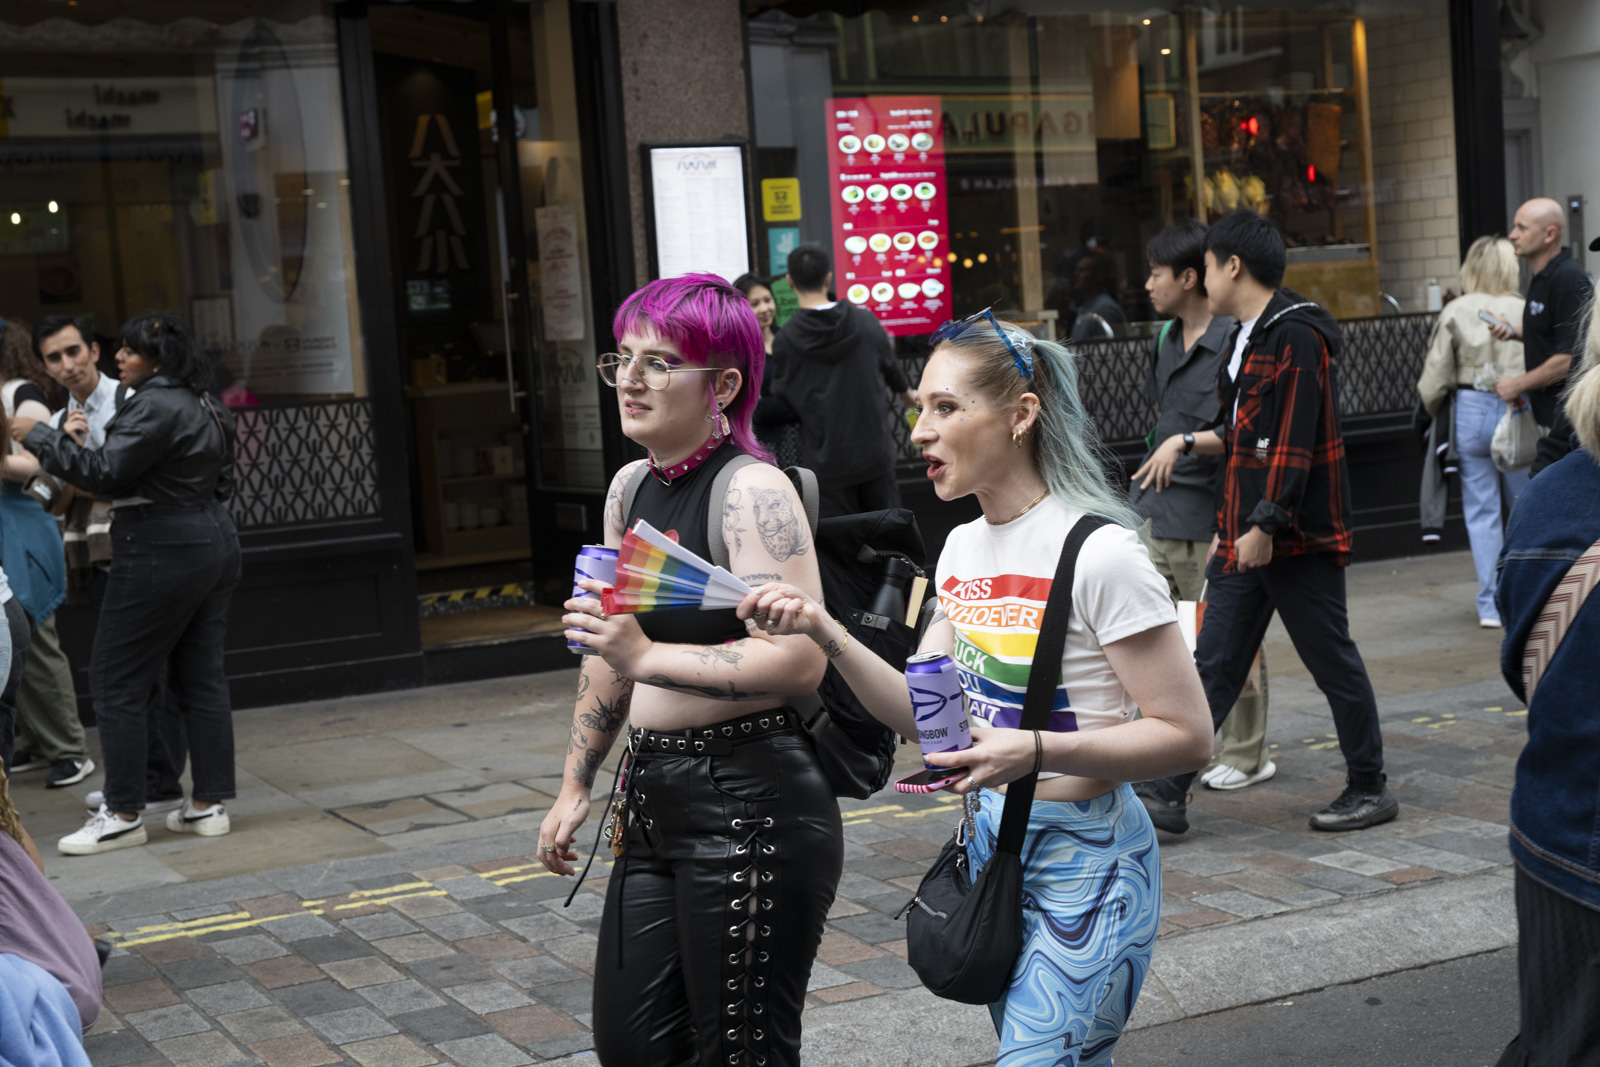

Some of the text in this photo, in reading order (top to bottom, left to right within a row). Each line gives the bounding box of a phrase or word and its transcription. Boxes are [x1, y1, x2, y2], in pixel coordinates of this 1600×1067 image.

[951, 579, 992, 599] KISS
[942, 599, 1038, 628] WHOEVER
[954, 636, 988, 674] UCK
[957, 669, 982, 693] OU
